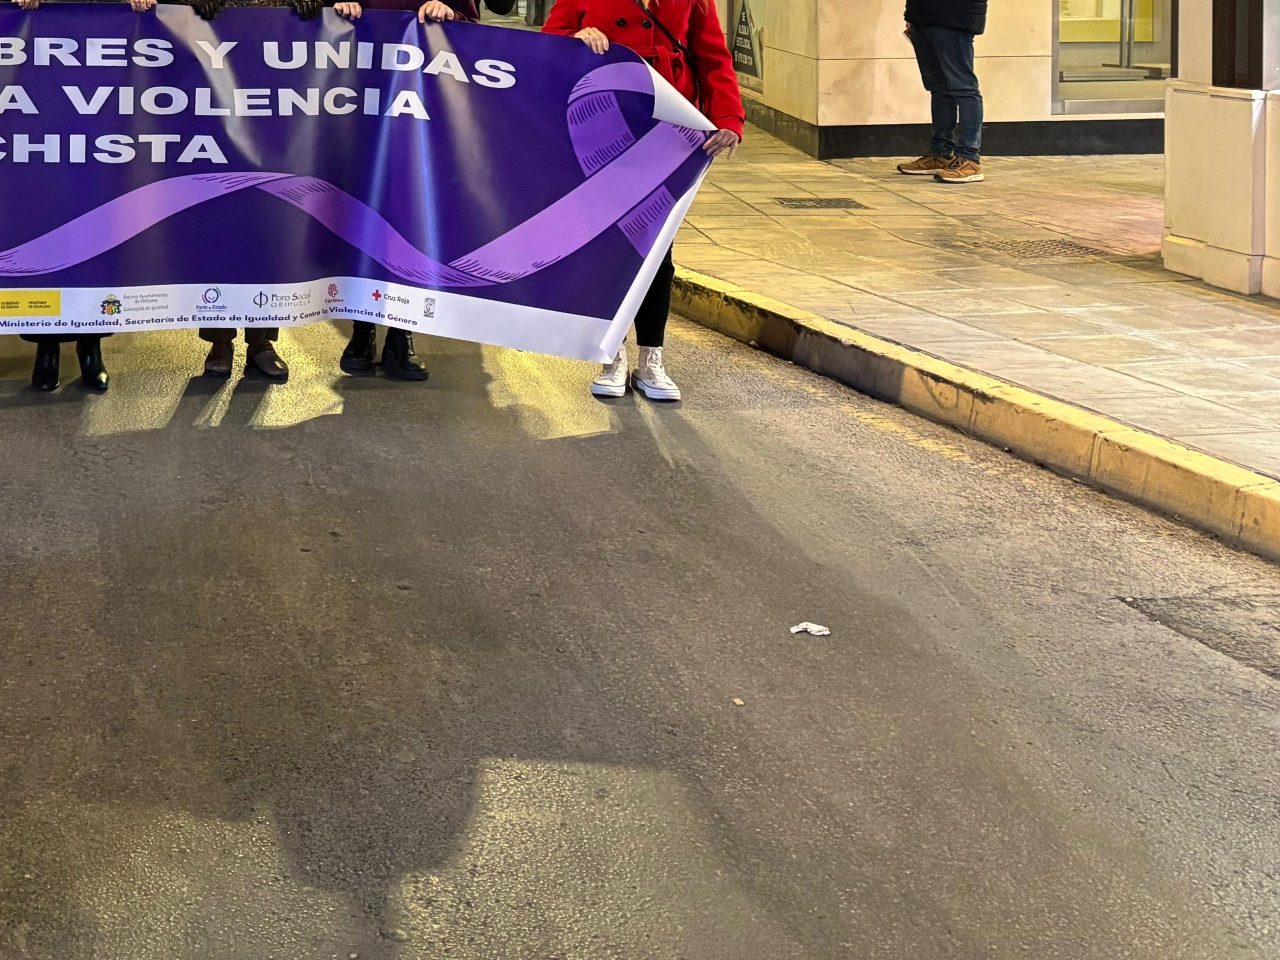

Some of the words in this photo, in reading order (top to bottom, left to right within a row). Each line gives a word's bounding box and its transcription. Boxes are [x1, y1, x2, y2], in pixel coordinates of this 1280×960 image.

[194, 40, 237, 70] Y
[262, 40, 517, 89] UNIDAS
[66, 86, 431, 120] VIOLENCIA
[271, 293, 290, 302] Foro
[383, 293, 396, 301] Cruz
[397, 295, 410, 305] Roja
[54, 319, 68, 327] de
[70, 319, 122, 329] Igualdad,
[124, 315, 174, 325] Secretaría
[191, 314, 226, 322] Estado
[245, 313, 291, 324] Igualdad
[292, 314, 299, 322] y
[299, 310, 321, 319] Contra
[329, 306, 373, 317] Violencia
[375, 311, 385, 319] de
[387, 311, 418, 326] Género
